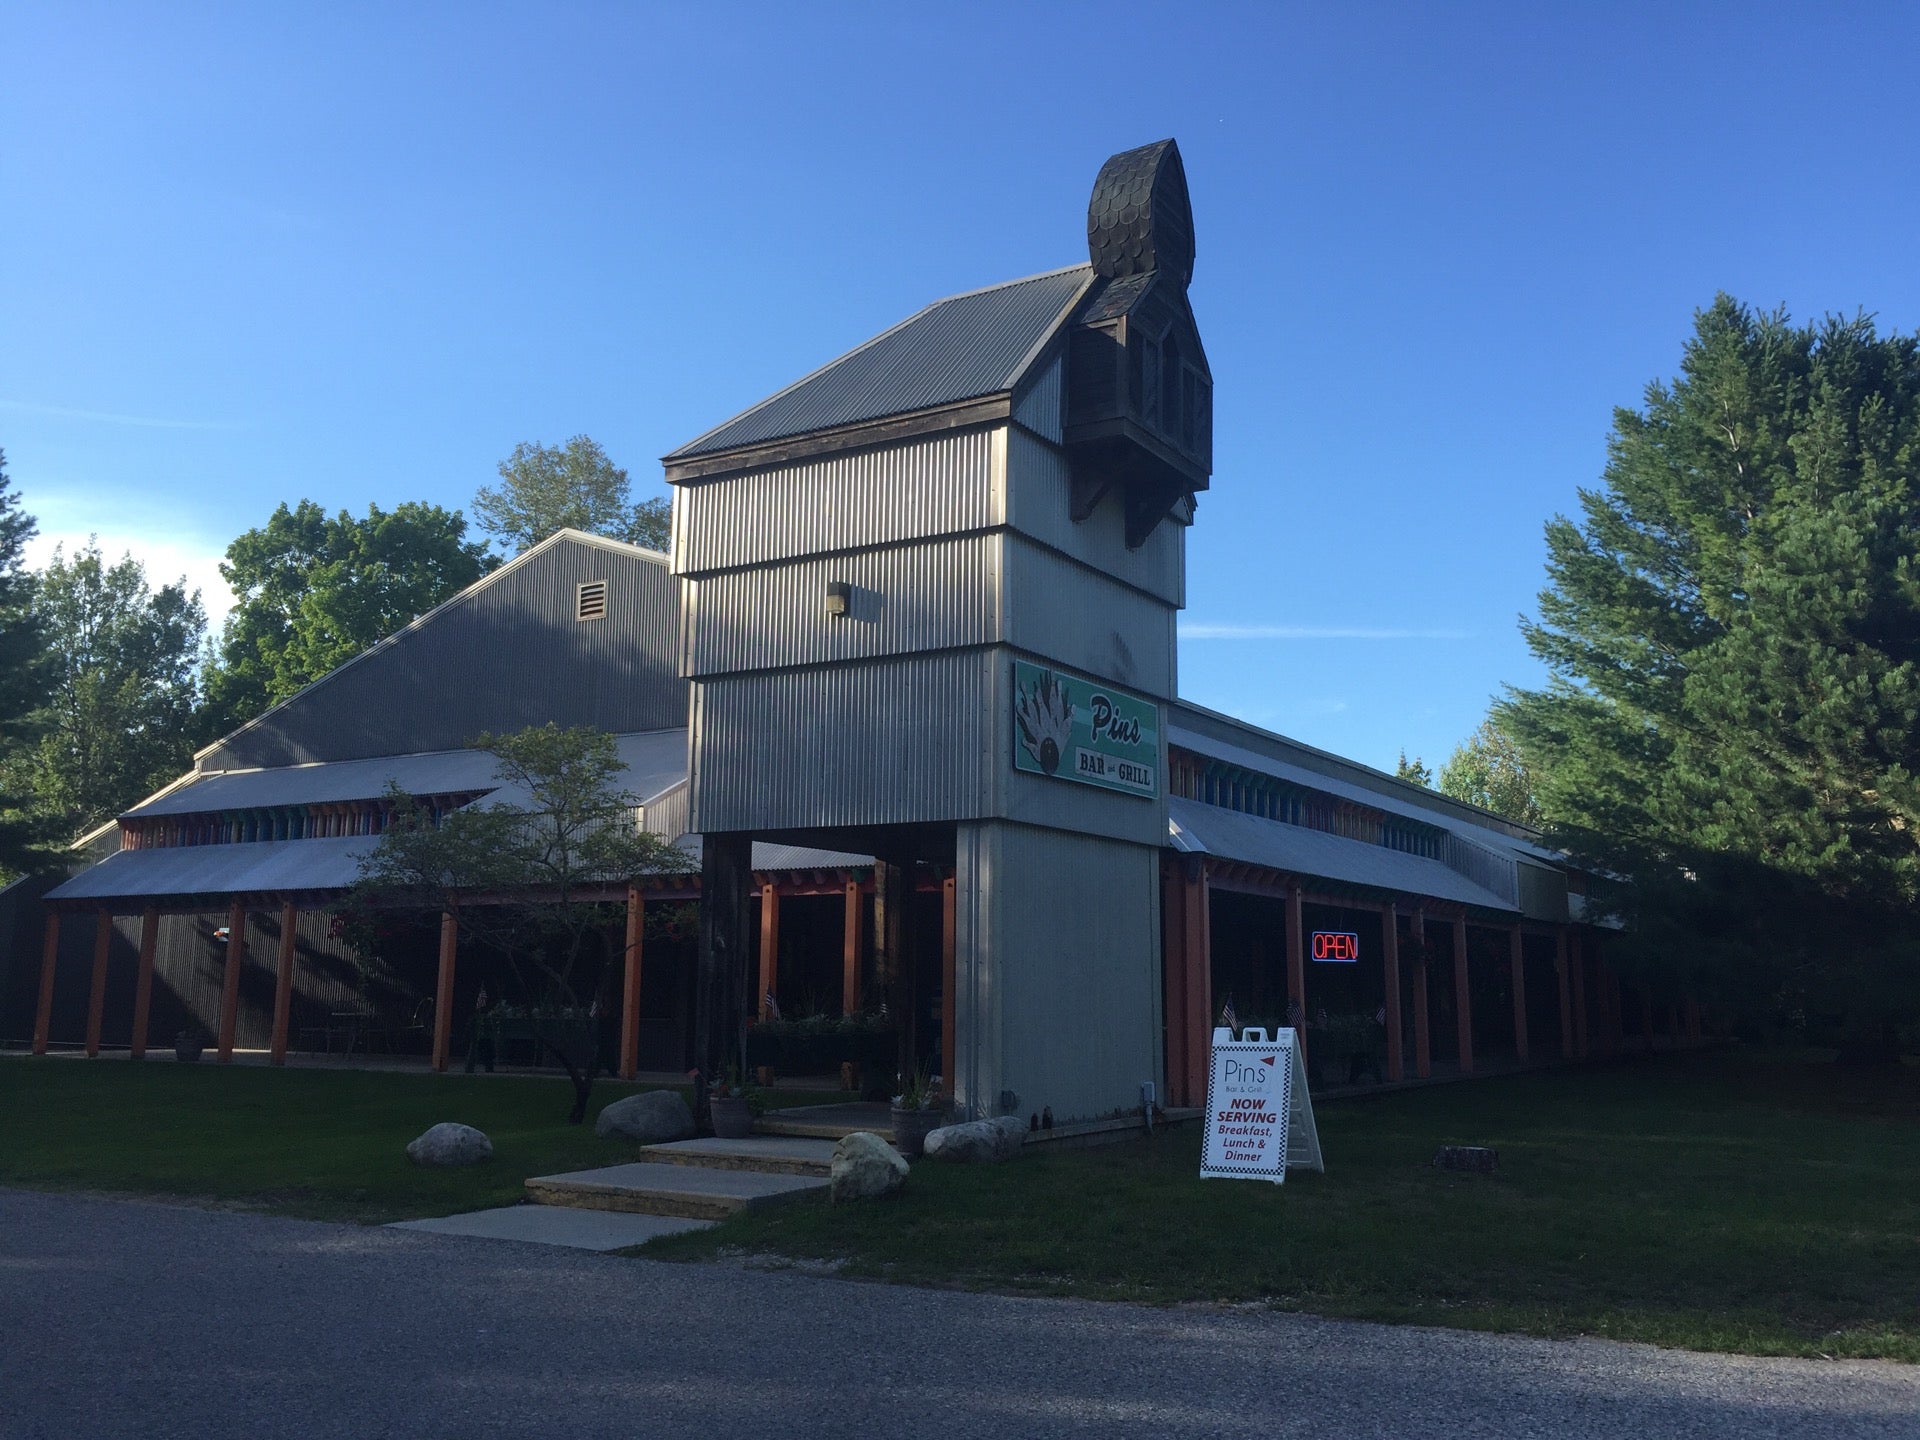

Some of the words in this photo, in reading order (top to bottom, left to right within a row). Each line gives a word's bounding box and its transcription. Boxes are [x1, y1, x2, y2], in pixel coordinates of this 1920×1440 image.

[1090, 694, 1142, 744] Pins
[1080, 752, 1105, 775] BAR
[1118, 763, 1150, 786] GRILL
[1314, 934, 1356, 959] OPEN
[1224, 1059, 1266, 1083] Pins
[1230, 1098, 1266, 1110] NOW
[1217, 1111, 1277, 1124] SERVING
[1218, 1124, 1273, 1137] Breakfast,
[1222, 1137, 1255, 1149] Lunch
[1257, 1138, 1266, 1149] &
[1225, 1150, 1262, 1162] Dinner
